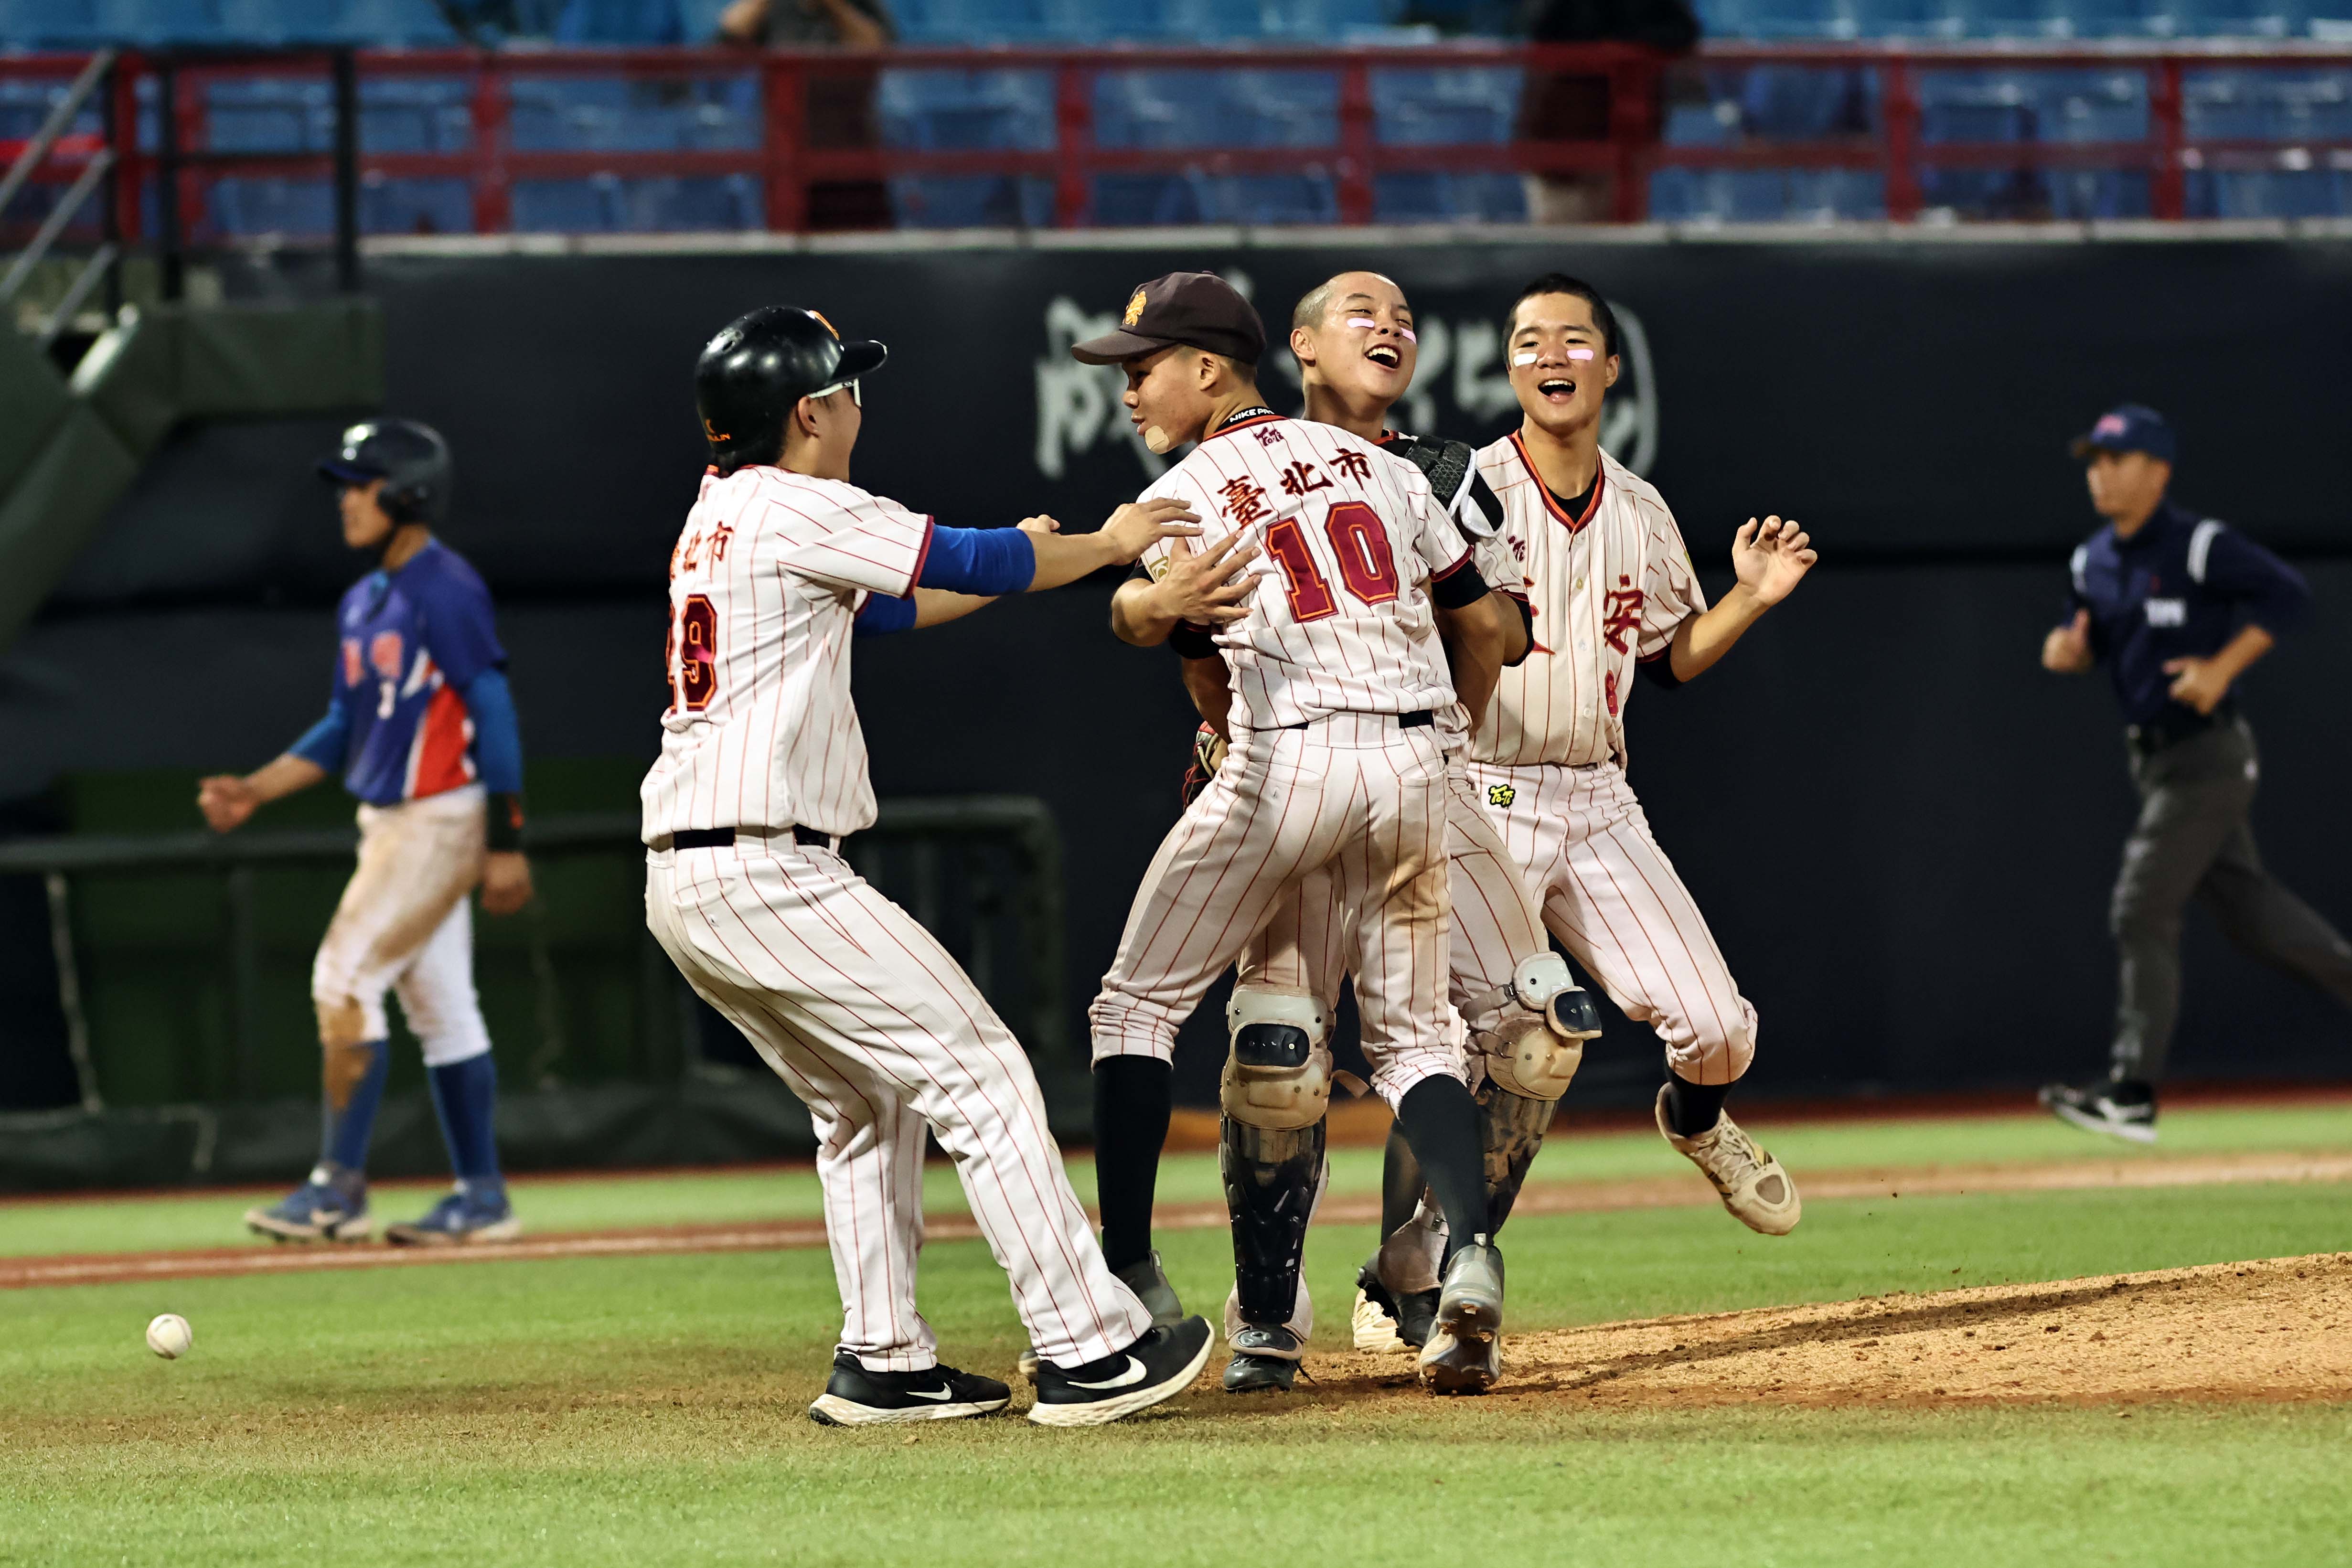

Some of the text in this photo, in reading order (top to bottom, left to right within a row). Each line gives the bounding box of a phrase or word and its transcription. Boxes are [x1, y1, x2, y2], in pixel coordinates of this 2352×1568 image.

[1229, 409, 1257, 423] NIKE
[1217, 448, 1372, 531] 臺北市
[1266, 500, 1400, 624] 10
